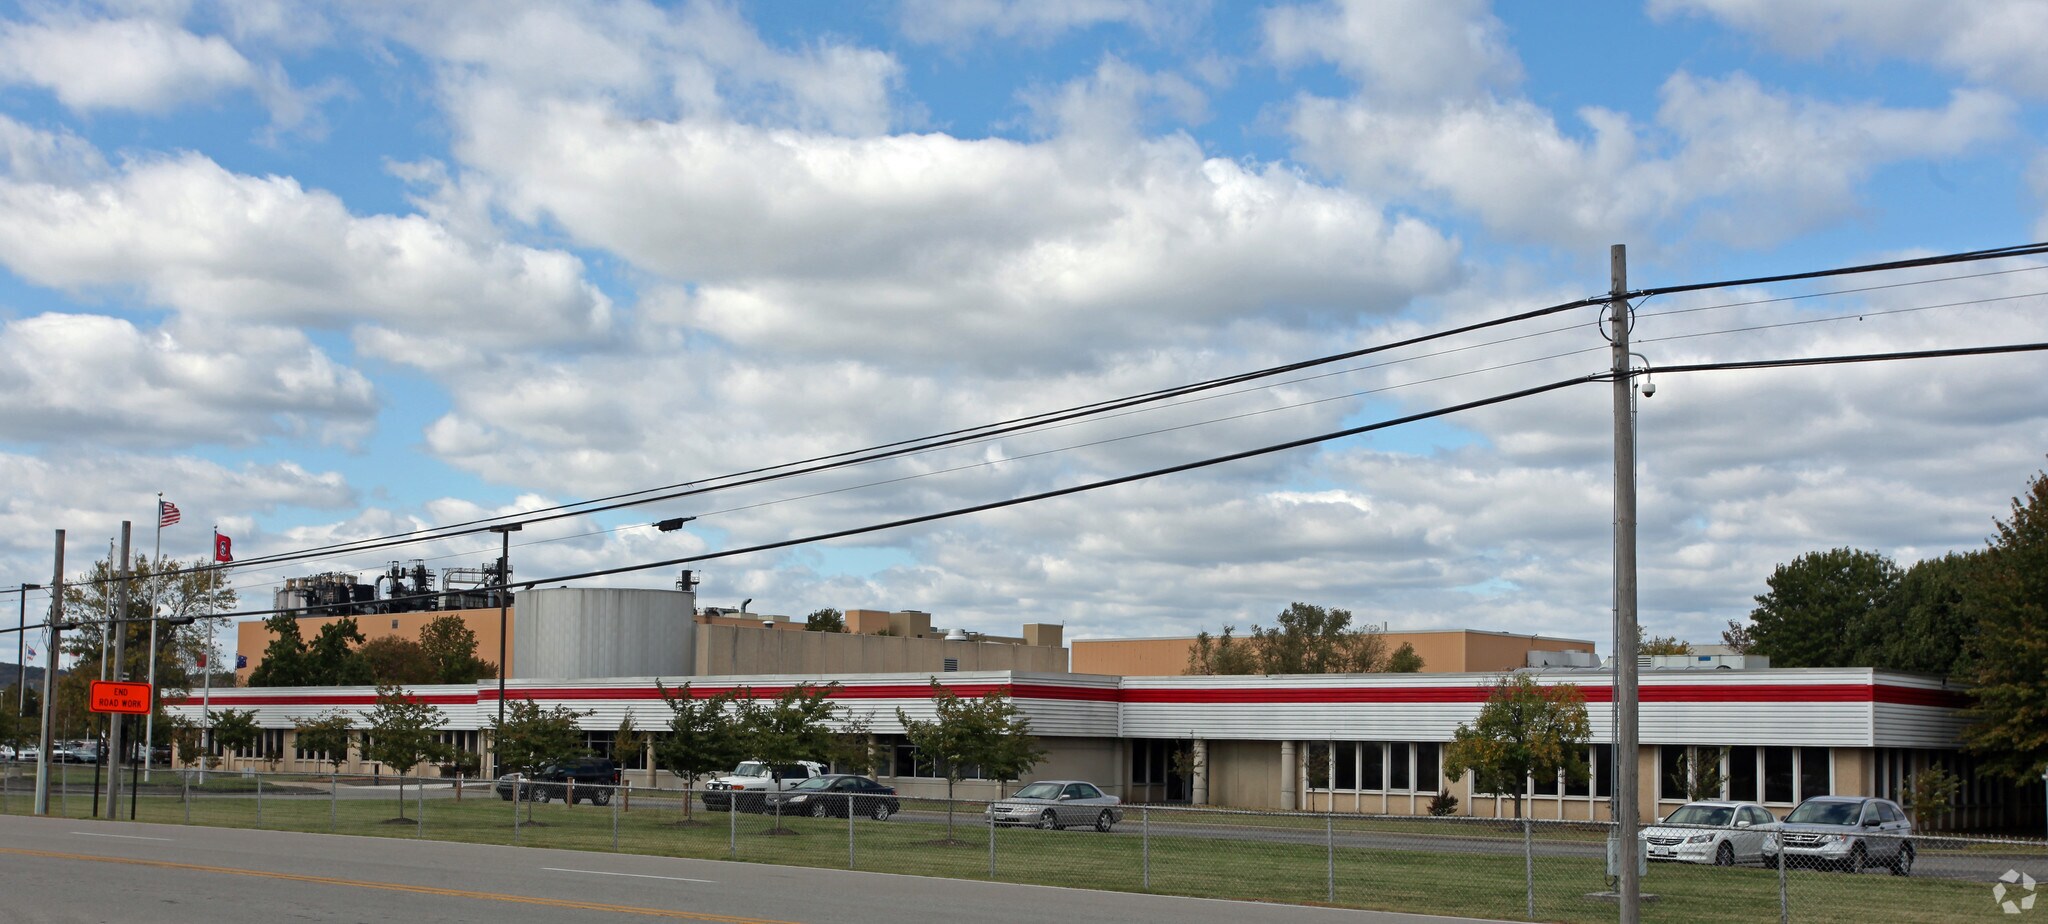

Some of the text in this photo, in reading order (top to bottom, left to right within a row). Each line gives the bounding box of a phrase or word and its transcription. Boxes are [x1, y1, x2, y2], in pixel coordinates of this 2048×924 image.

[114, 688, 128, 696] END
[99, 698, 141, 708] ROAD WORK
